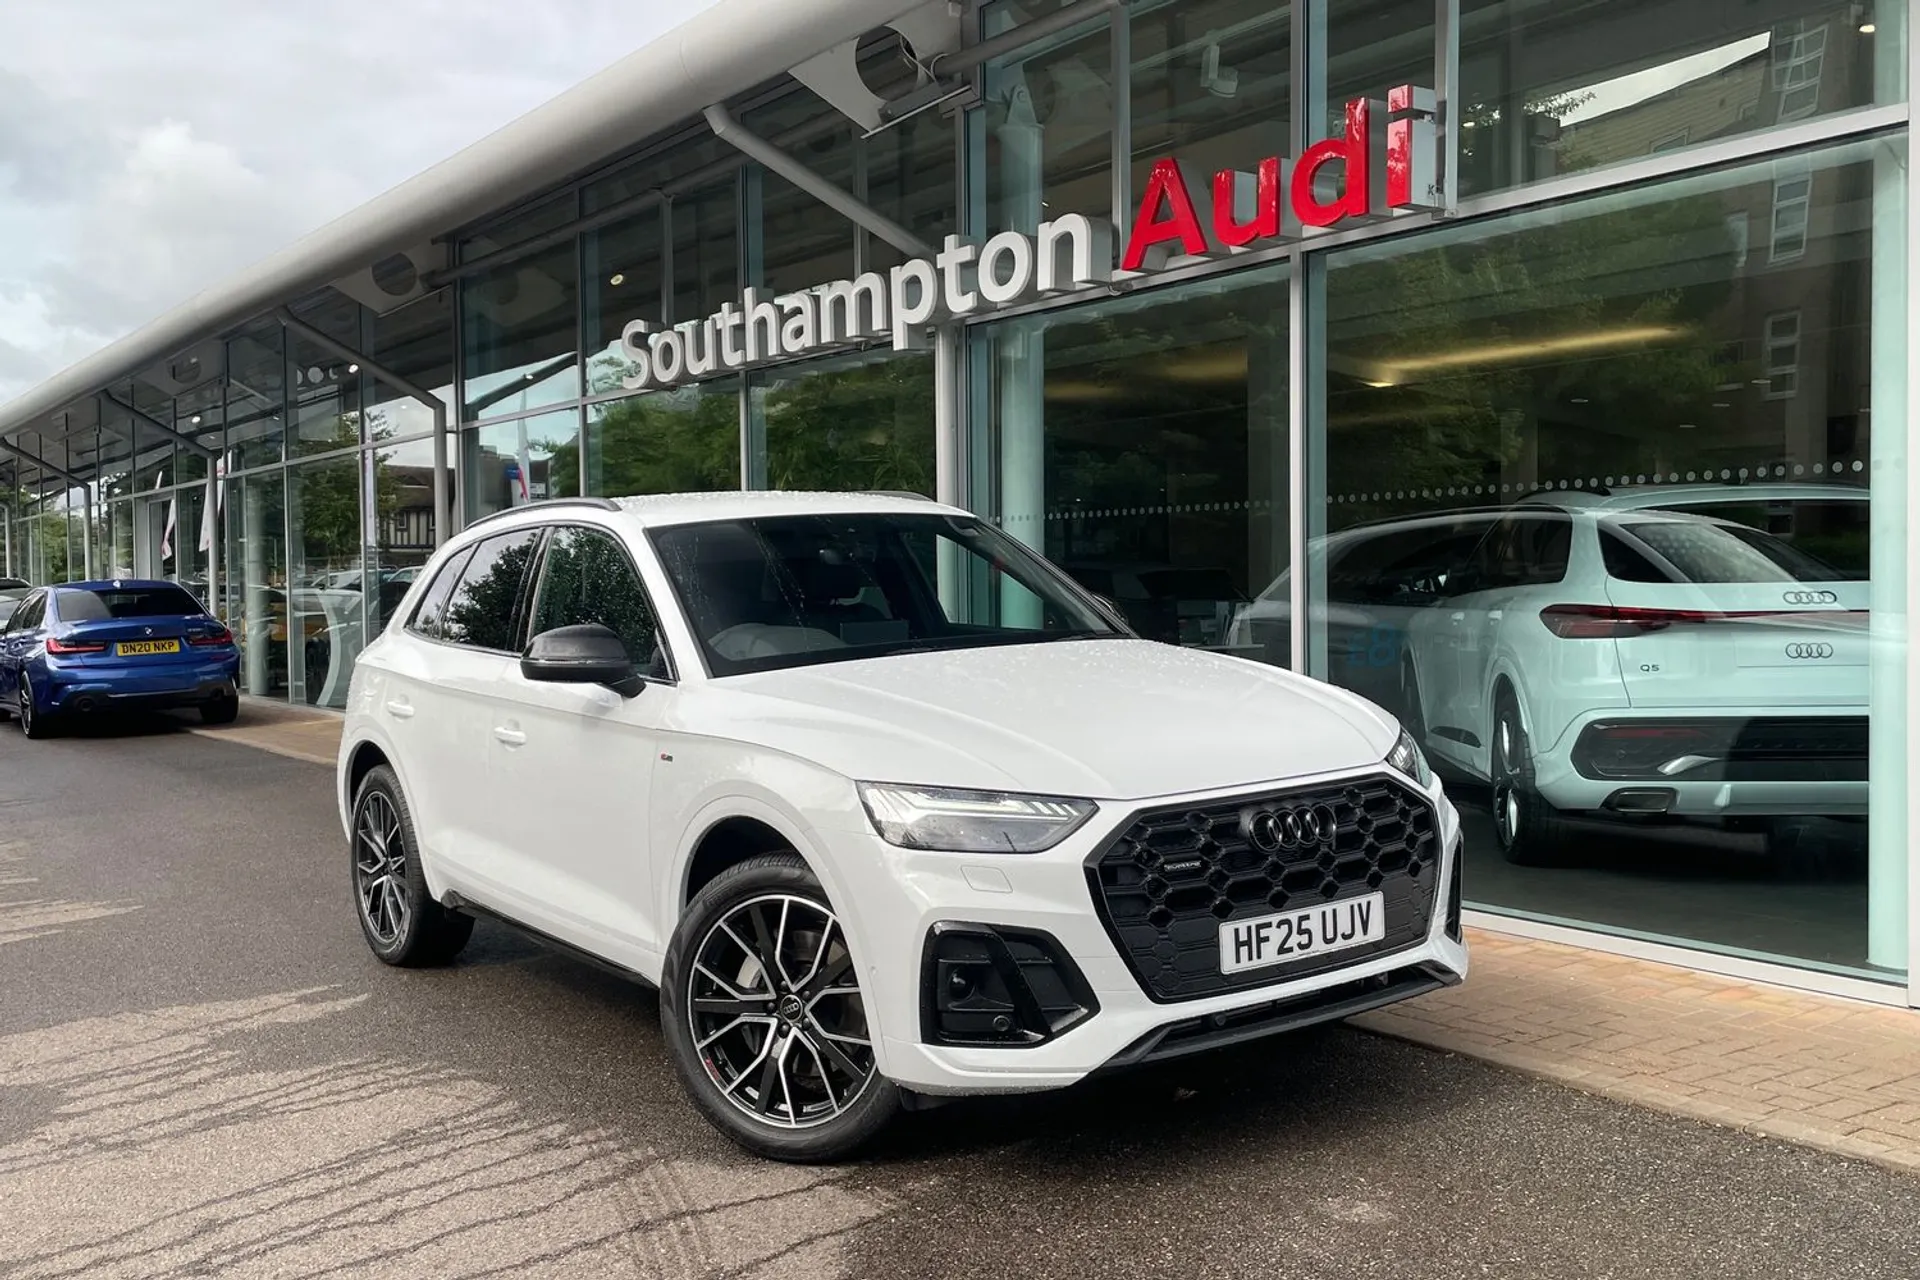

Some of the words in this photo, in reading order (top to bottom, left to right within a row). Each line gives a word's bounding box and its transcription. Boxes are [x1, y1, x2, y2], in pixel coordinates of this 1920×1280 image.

[620, 211, 1093, 390] Southampton
[1120, 84, 1414, 272] Audi
[121, 640, 150, 654] DN20
[153, 640, 175, 652] NKP
[1639, 664, 1660, 672] Q5
[1233, 913, 1313, 964] HF25
[1321, 900, 1371, 945] UJV
